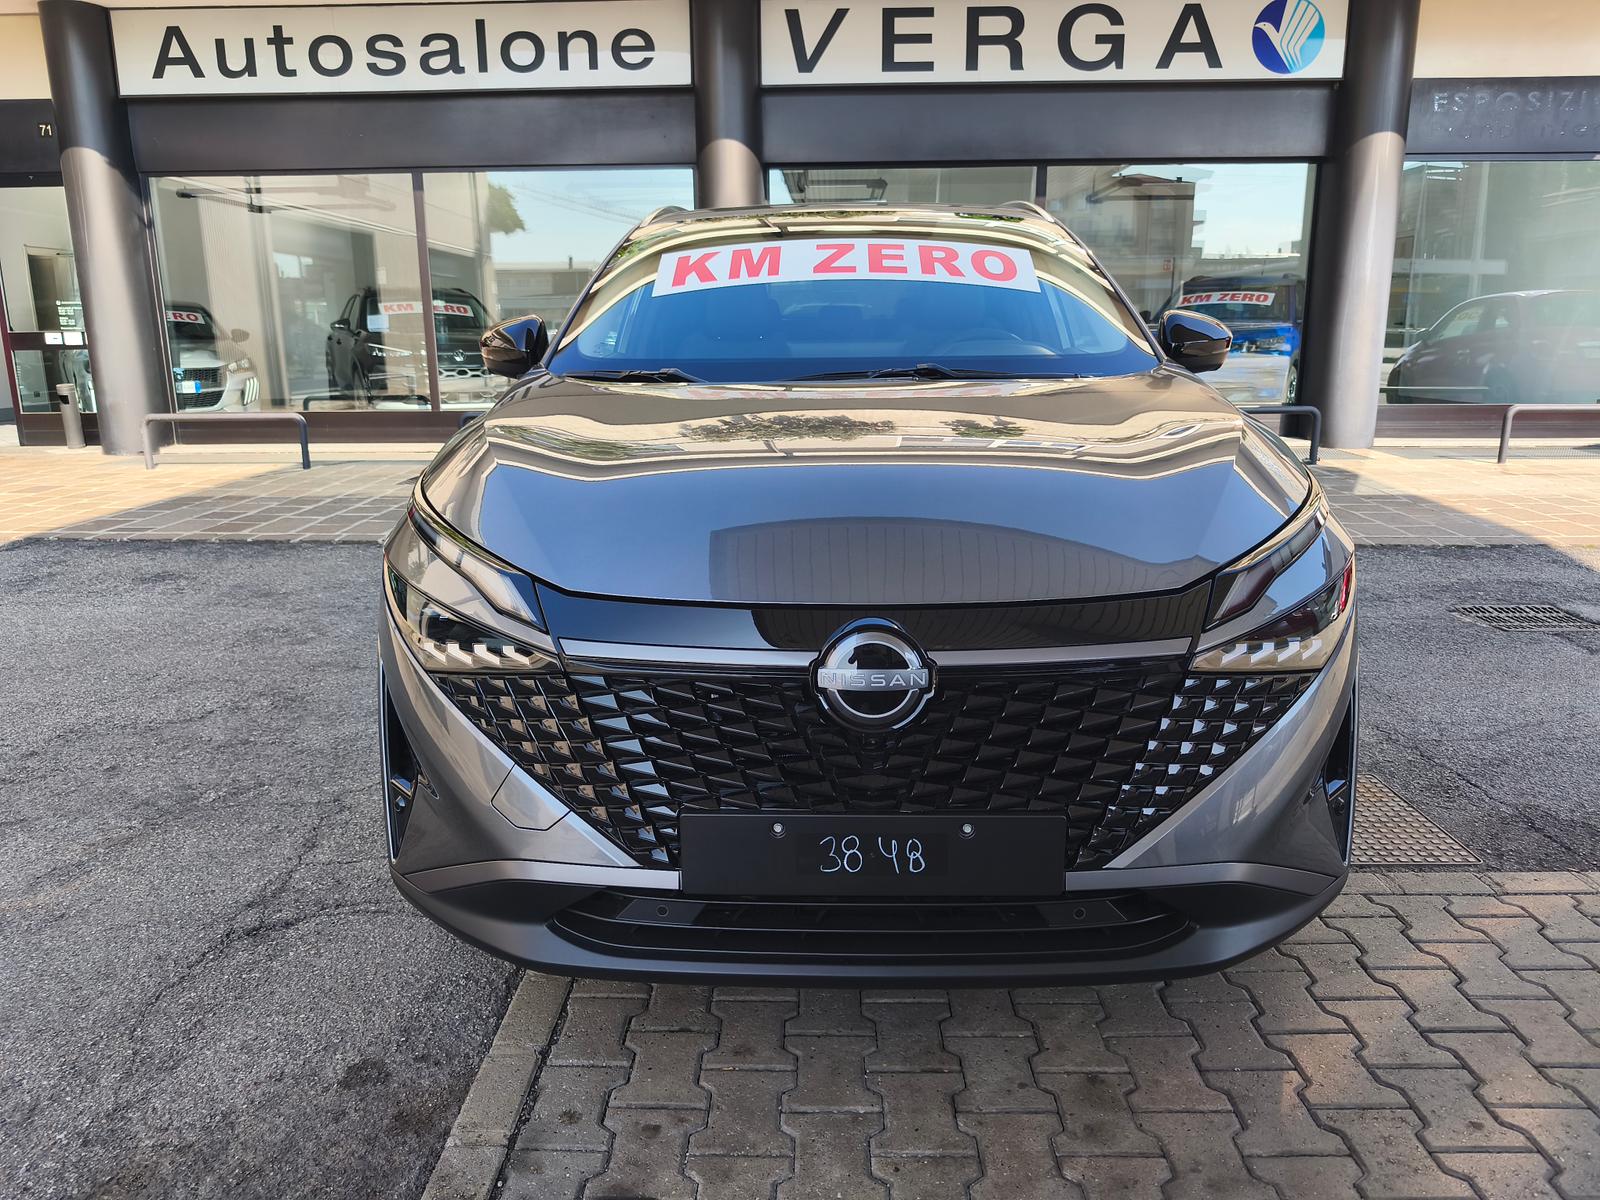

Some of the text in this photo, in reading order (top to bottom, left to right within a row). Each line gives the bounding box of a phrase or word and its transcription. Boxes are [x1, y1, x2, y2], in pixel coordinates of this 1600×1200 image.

[152, 19, 656, 79] Autosalone
[784, 3, 1223, 73] VERGA
[1433, 90, 1600, 112] ESPOSIZI
[39, 124, 52, 136] 71
[671, 243, 1017, 287] KM ZERO
[383, 303, 414, 313] KM
[1182, 293, 1269, 305] KM ZERO
[821, 673, 926, 687] NISSAN
[820, 835, 863, 872] 38
